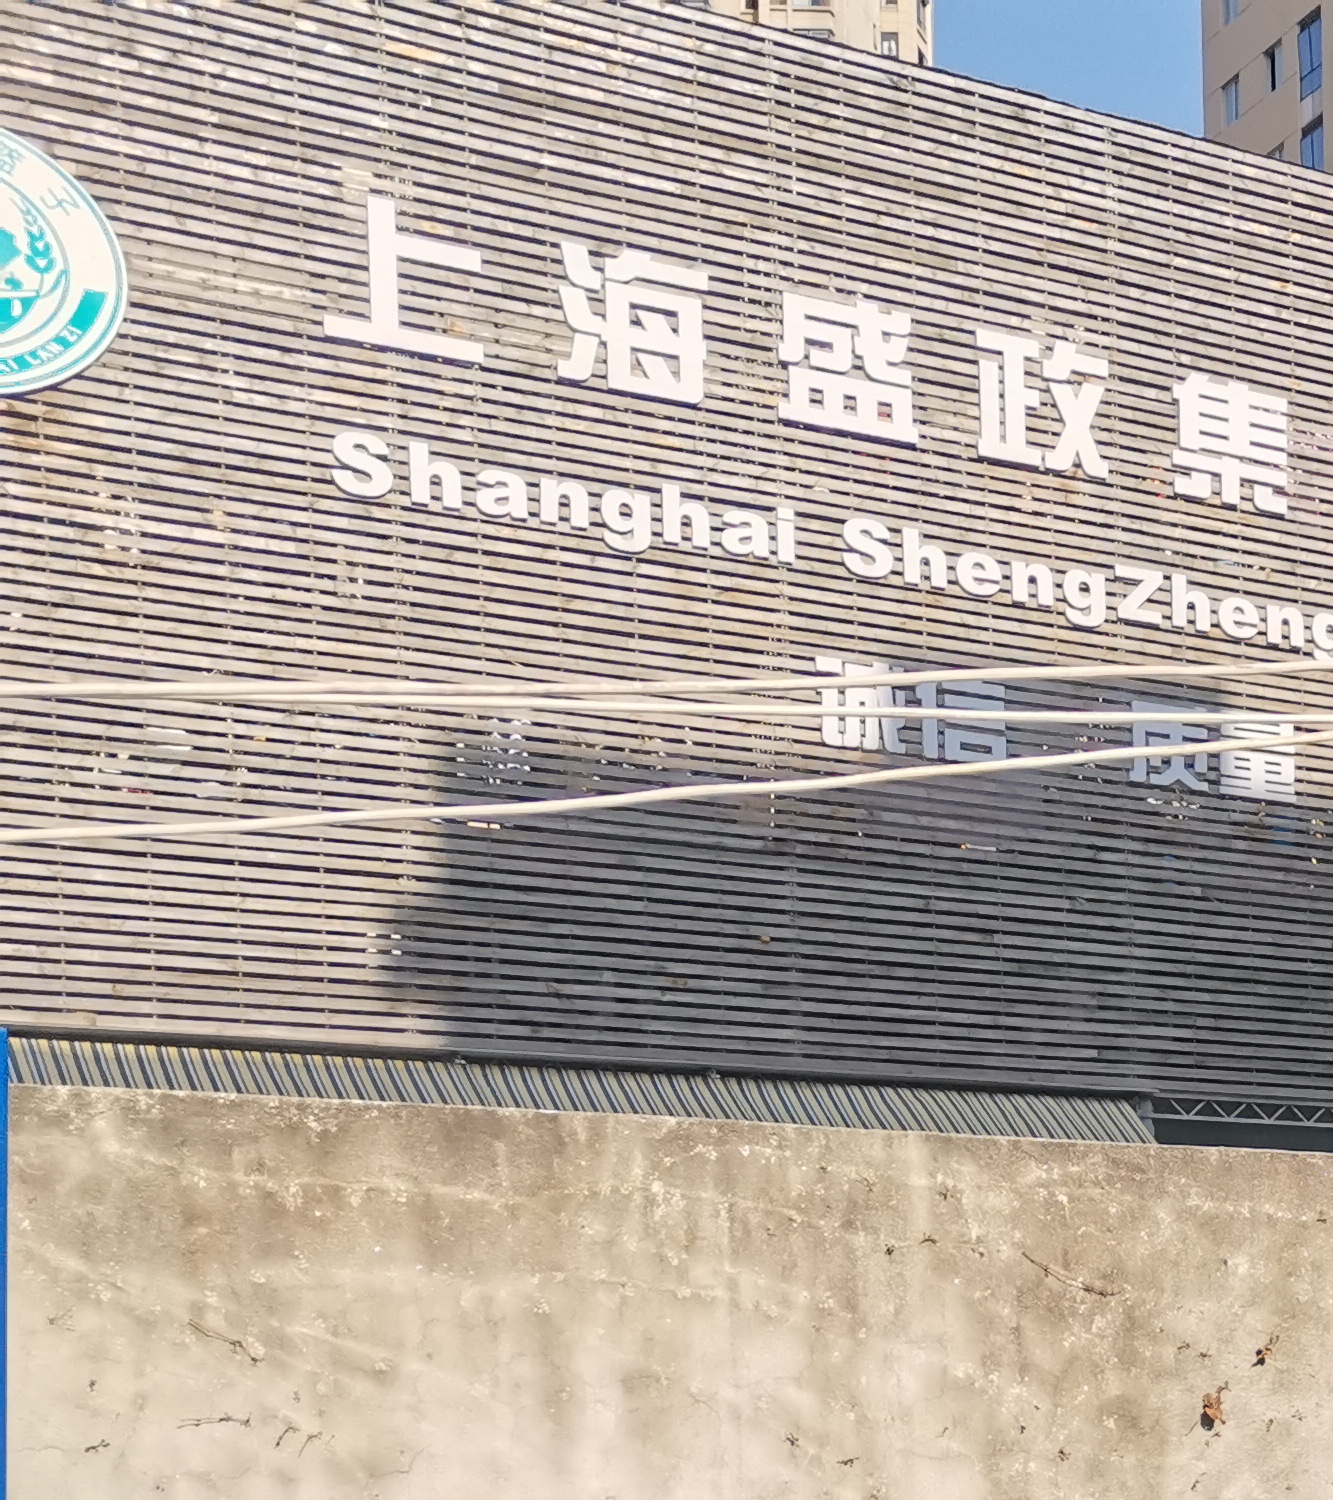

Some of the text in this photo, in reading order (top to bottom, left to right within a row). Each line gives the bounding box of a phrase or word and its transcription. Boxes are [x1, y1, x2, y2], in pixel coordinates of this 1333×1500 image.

[330, 431, 796, 564] Shanghai
[814, 655, 1006, 763] 诚信
[1129, 699, 1297, 803] 质量
